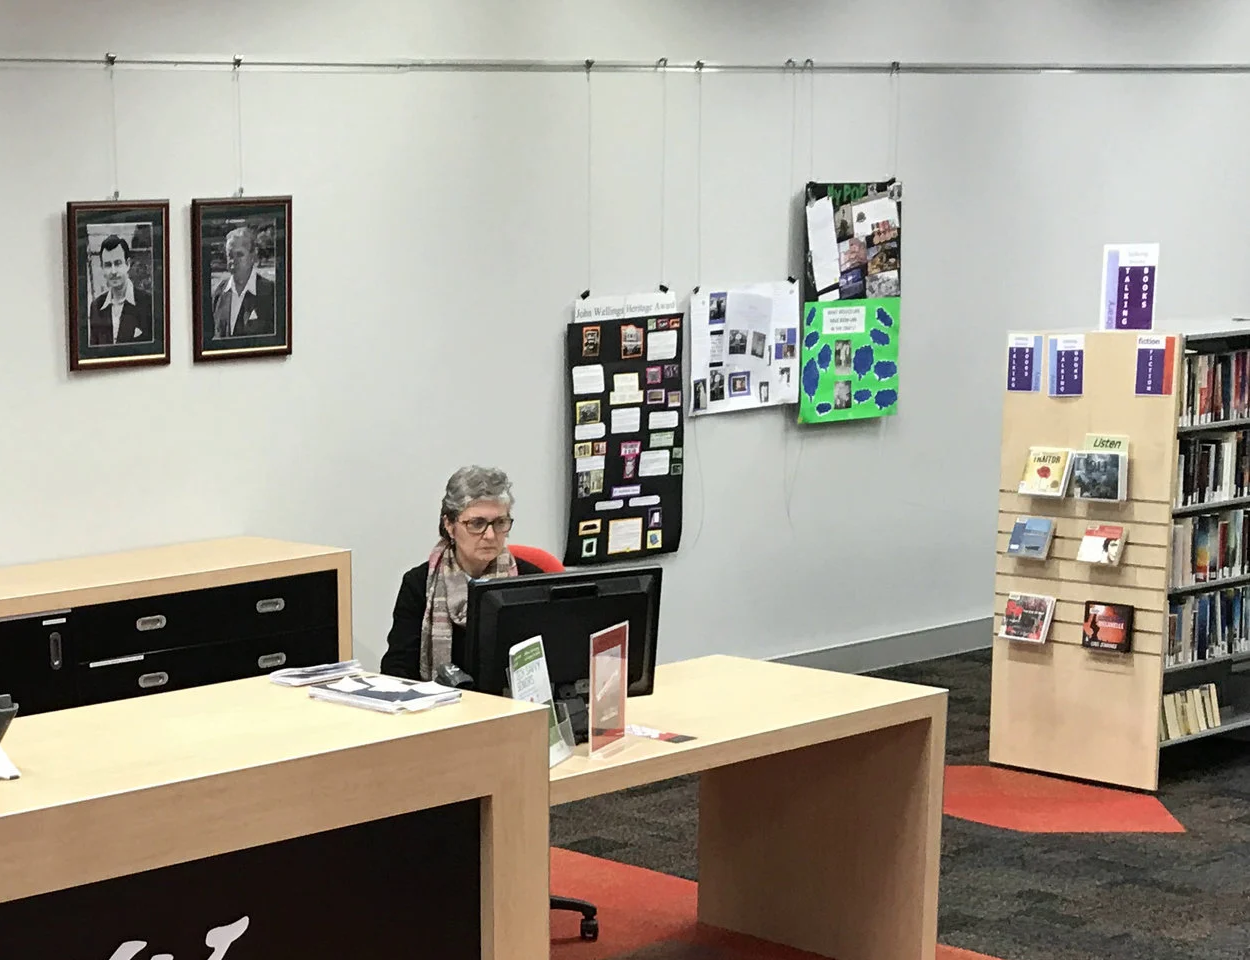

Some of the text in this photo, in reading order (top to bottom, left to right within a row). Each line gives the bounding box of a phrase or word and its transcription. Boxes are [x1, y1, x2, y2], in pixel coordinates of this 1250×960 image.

[843, 184, 867, 201] POP
[1122, 267, 1149, 325] TALKING BOOKS
[1093, 438, 1122, 450] Listen
